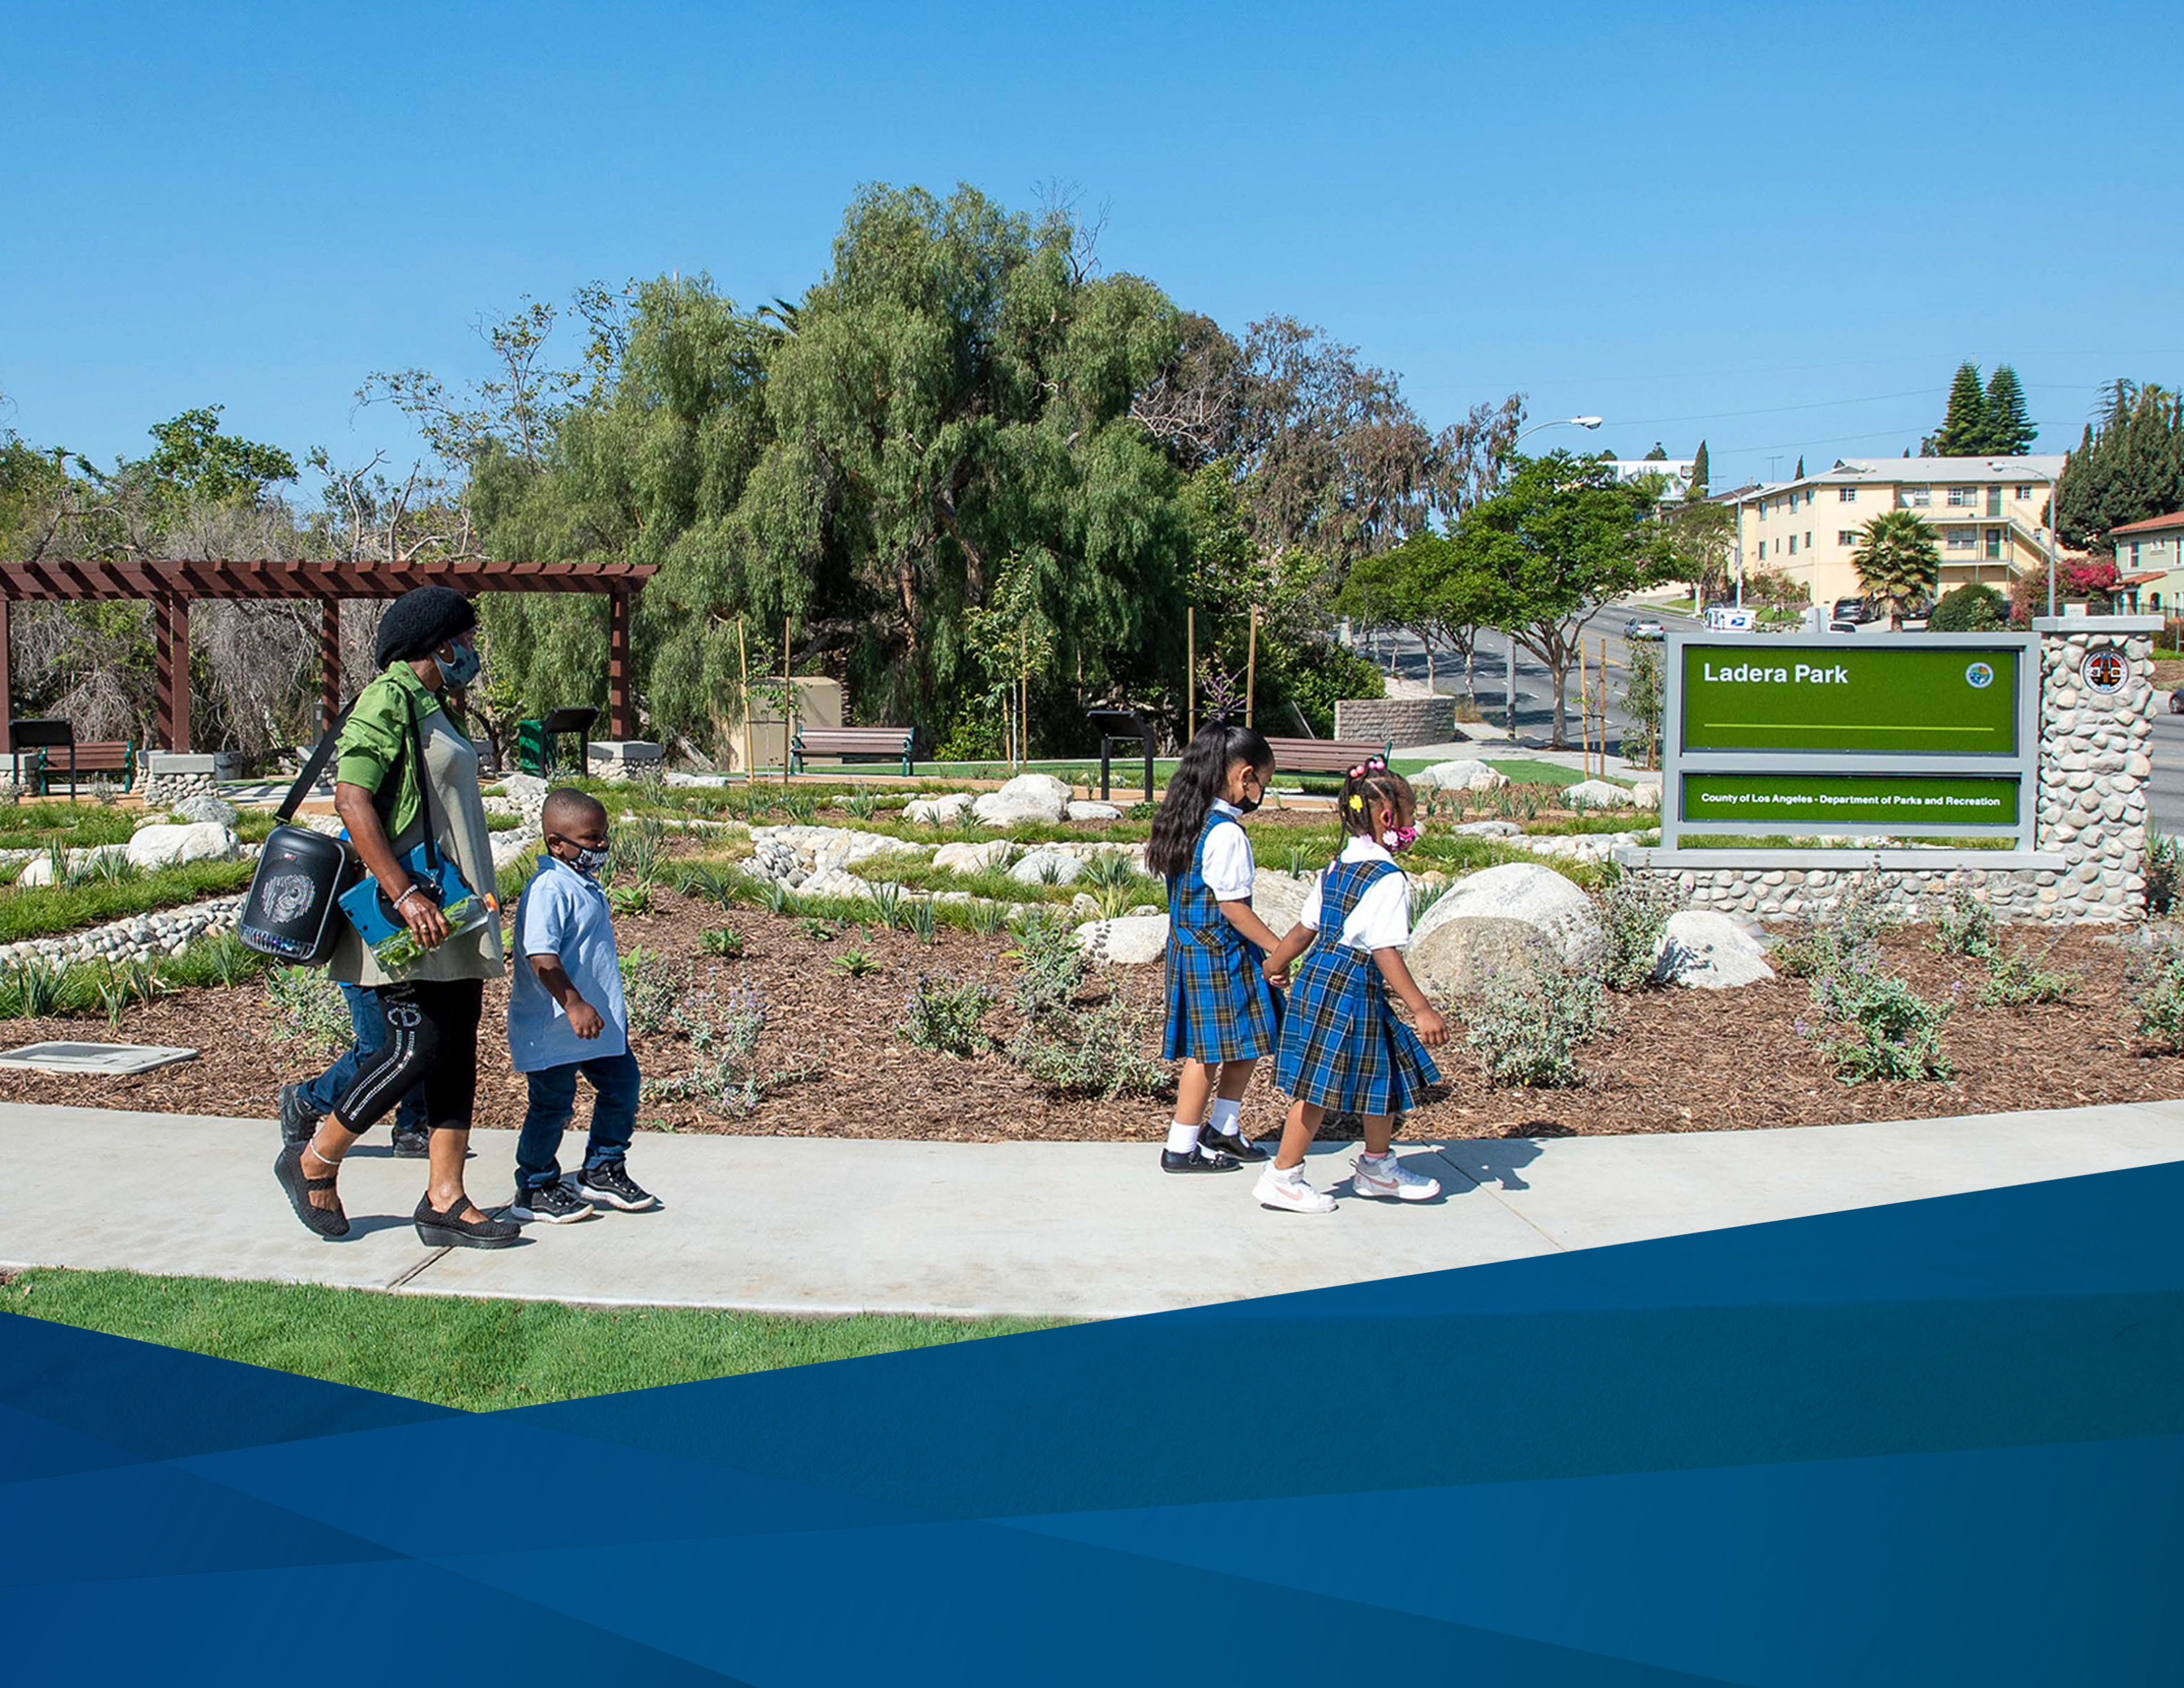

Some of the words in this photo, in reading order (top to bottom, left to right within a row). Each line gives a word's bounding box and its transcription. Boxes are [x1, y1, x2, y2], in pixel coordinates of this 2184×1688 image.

[1704, 663, 1788, 683] Ladera
[1795, 664, 1848, 684] Park
[1701, 793, 1738, 804] County
[1739, 794, 1751, 803] of
[1751, 794, 1770, 803] Los
[1772, 794, 1813, 805] Angeles
[1819, 794, 1879, 806] Department
[1880, 796, 1892, 805] of
[1893, 796, 1923, 805] Parks
[1924, 796, 1944, 806] and
[1946, 796, 2001, 806] Recreation
